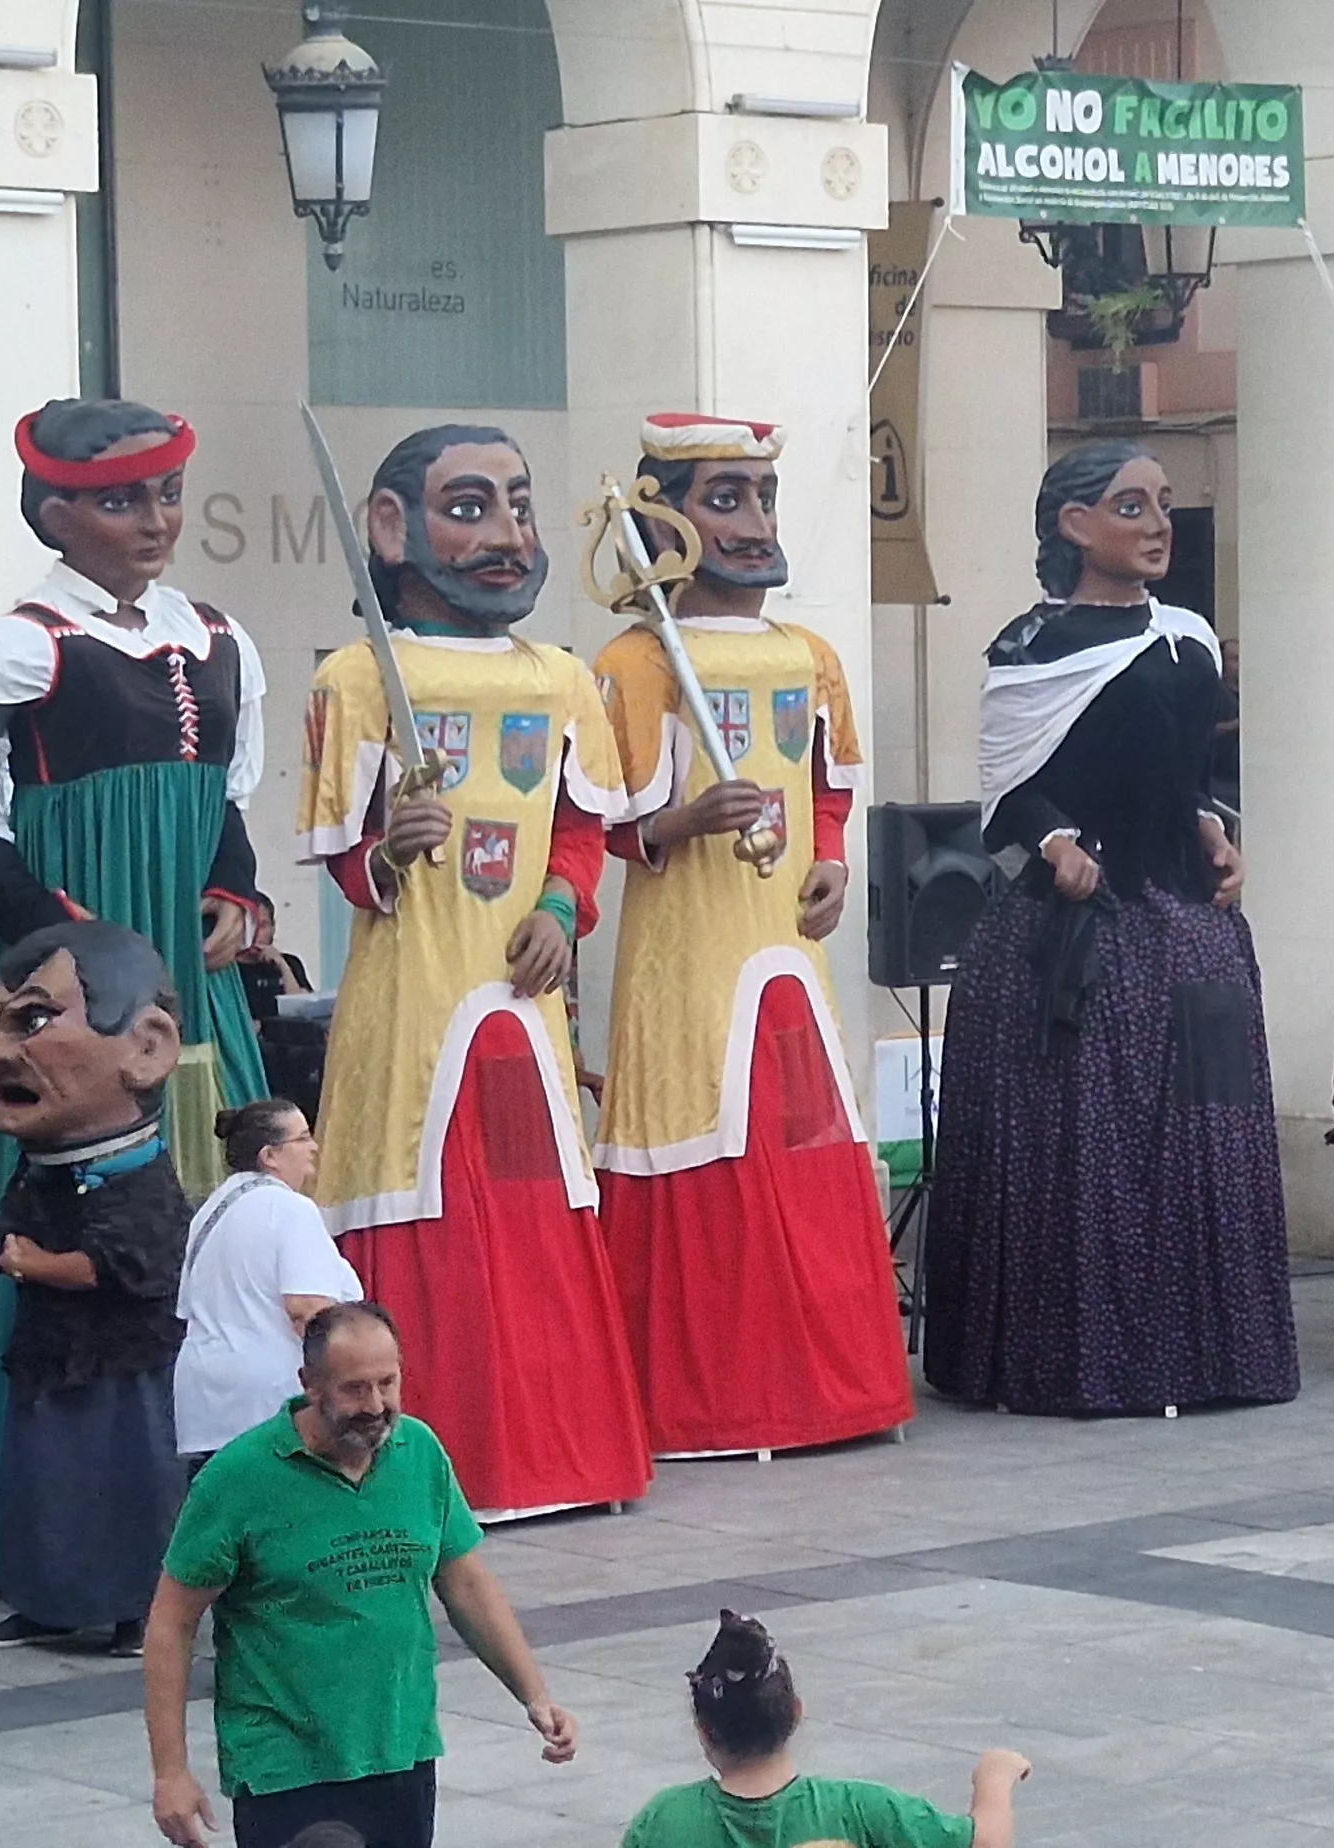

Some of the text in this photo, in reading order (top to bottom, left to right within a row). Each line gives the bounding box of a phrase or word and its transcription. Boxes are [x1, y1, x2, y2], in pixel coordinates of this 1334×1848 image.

[973, 87, 1289, 142] YO NO FACILITO
[977, 141, 1290, 188] ALCOHOL A MENORES
[870, 264, 917, 286] ficina
[343, 282, 465, 313] Naturaleza
